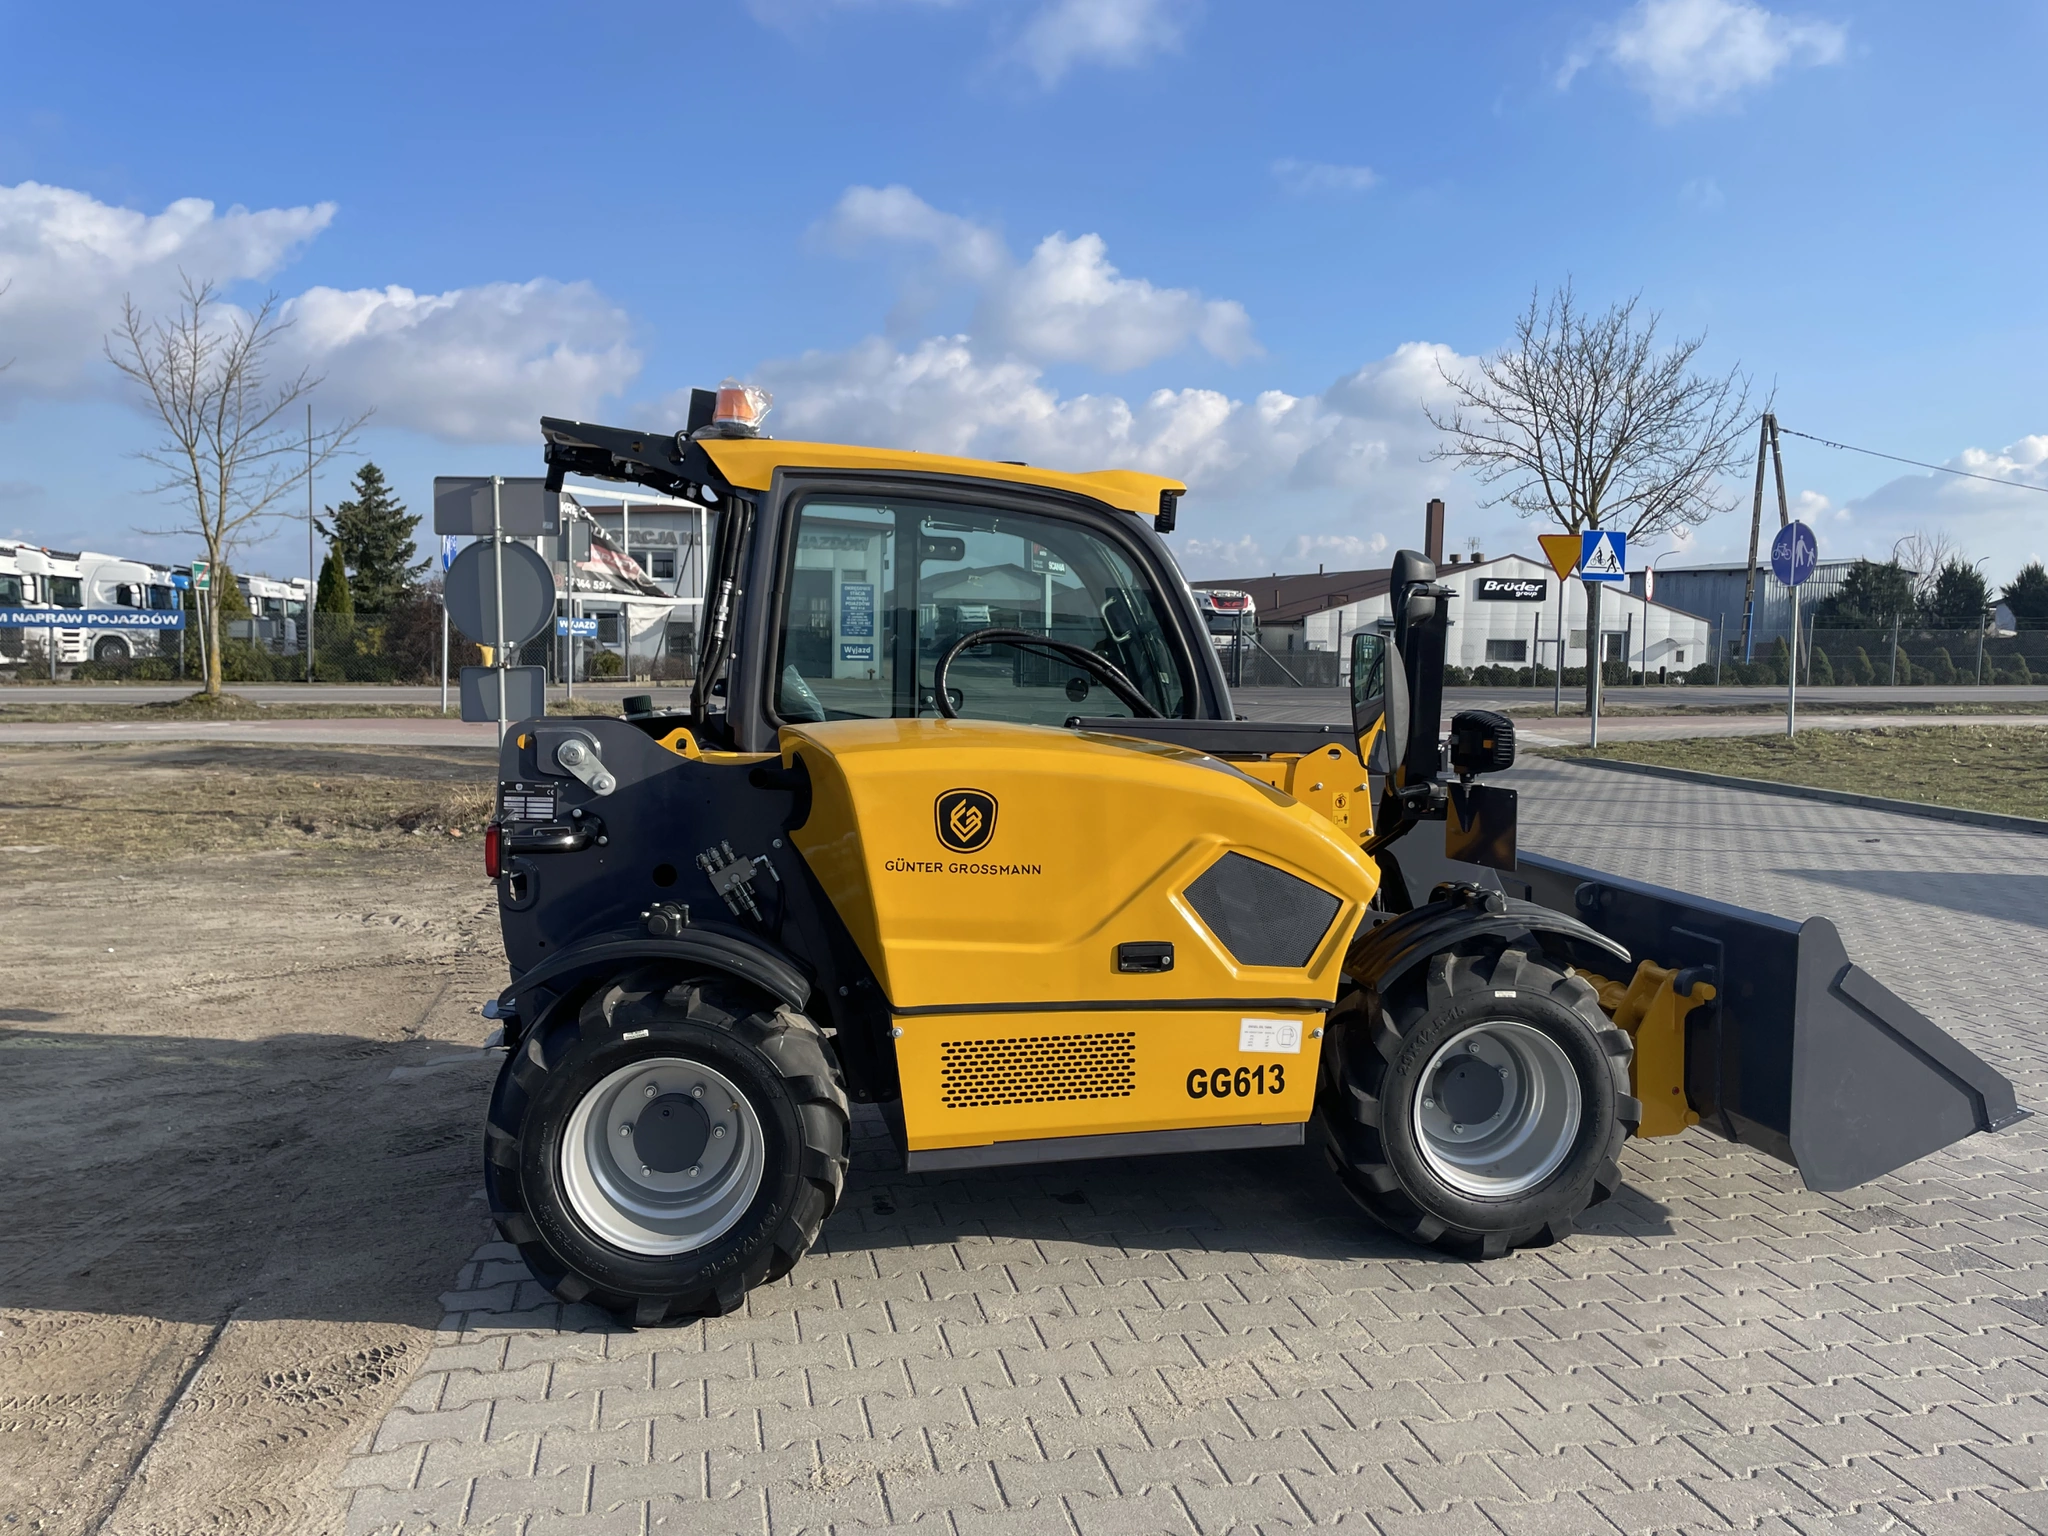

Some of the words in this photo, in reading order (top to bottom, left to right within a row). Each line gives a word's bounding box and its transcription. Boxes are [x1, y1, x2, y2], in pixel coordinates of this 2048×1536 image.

[609, 529, 678, 545] STACJA
[592, 580, 613, 590] 594
[1483, 580, 1543, 592] Brüder
[12, 613, 83, 623] NAPRAW
[88, 612, 179, 625] POJAZDÓW
[844, 646, 871, 654] Wyjazd
[885, 858, 943, 873] GÜNTER
[948, 862, 1042, 876] GROSSMANN
[1186, 1063, 1285, 1099] GG613
